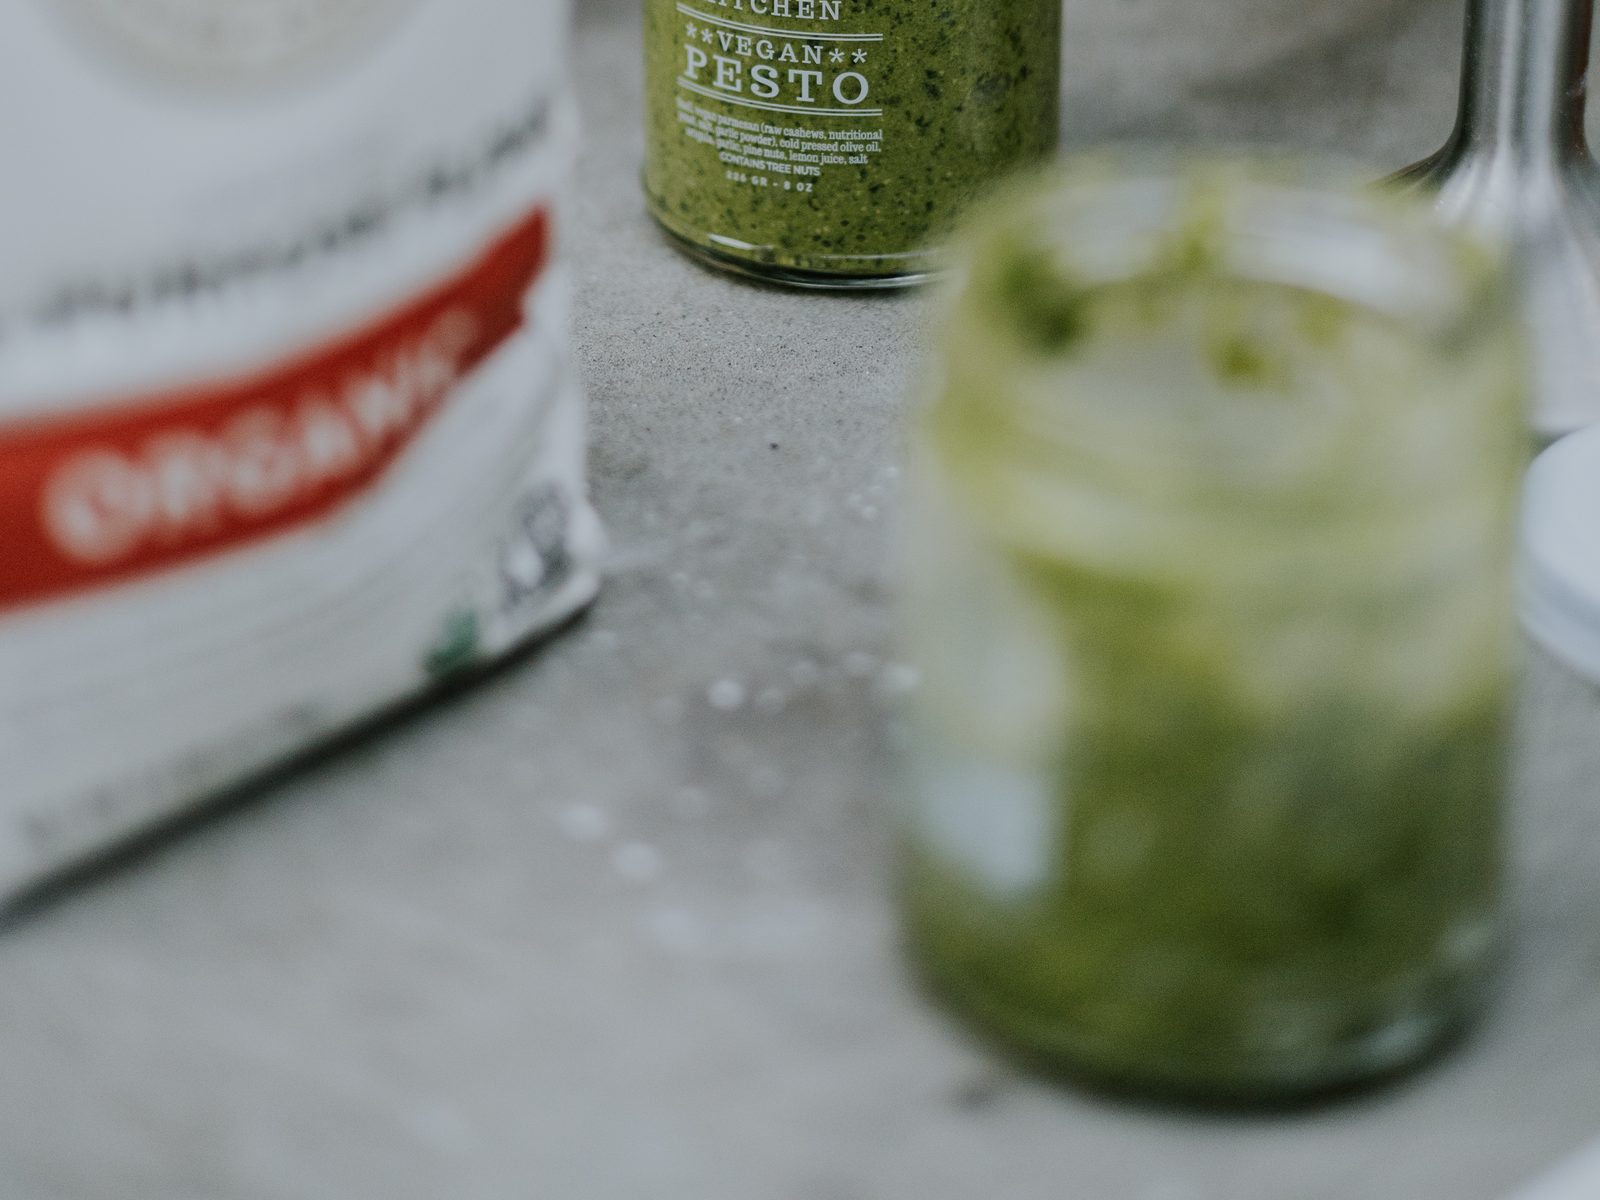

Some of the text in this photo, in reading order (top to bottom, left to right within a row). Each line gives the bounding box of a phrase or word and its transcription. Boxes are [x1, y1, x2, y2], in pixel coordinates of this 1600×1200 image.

[684, 44, 869, 104] PESTO
[761, 122, 782, 135] (raw
[828, 129, 883, 140] nutritional
[780, 138, 800, 149] cold
[801, 141, 838, 152] pressed
[840, 142, 864, 152] olive
[720, 151, 821, 176] CONTAINS TREE NUTS
[789, 150, 818, 162] lemon
[848, 154, 868, 165] salt
[796, 182, 813, 192] OZ
